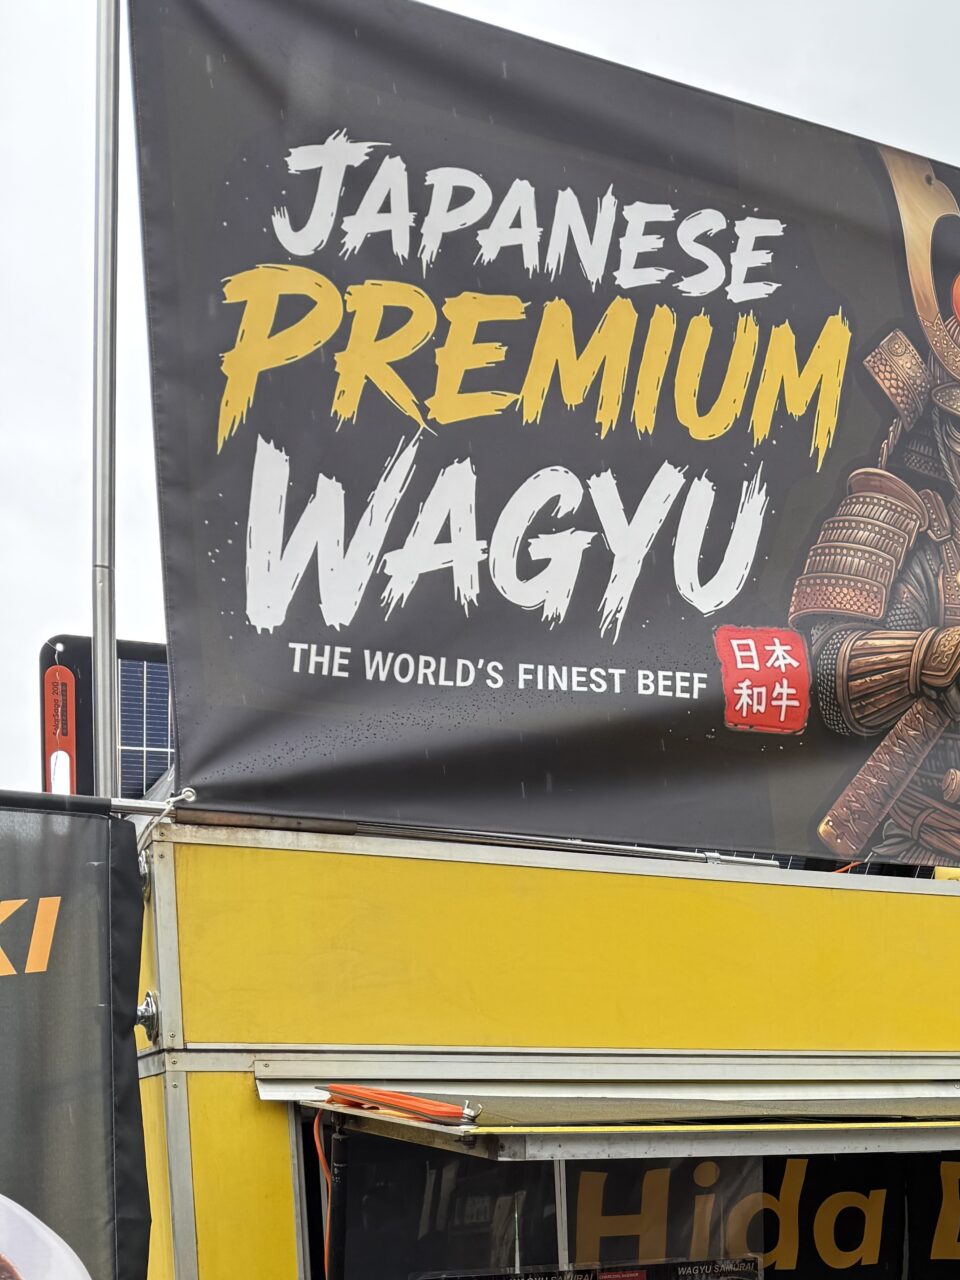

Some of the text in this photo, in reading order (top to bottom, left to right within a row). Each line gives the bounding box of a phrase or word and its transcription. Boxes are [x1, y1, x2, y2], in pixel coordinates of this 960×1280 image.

[272, 129, 786, 302] JAPANESE
[217, 264, 851, 472] PREMIUM
[245, 426, 768, 644] WAGYU
[289, 642, 708, 699] THE WORLD'S FINEST BEEF
[730, 637, 800, 673] 日本
[732, 679, 800, 722] 和牛
[576, 1158, 886, 1270] Hida
[678, 1264, 712, 1276] WAGYU
